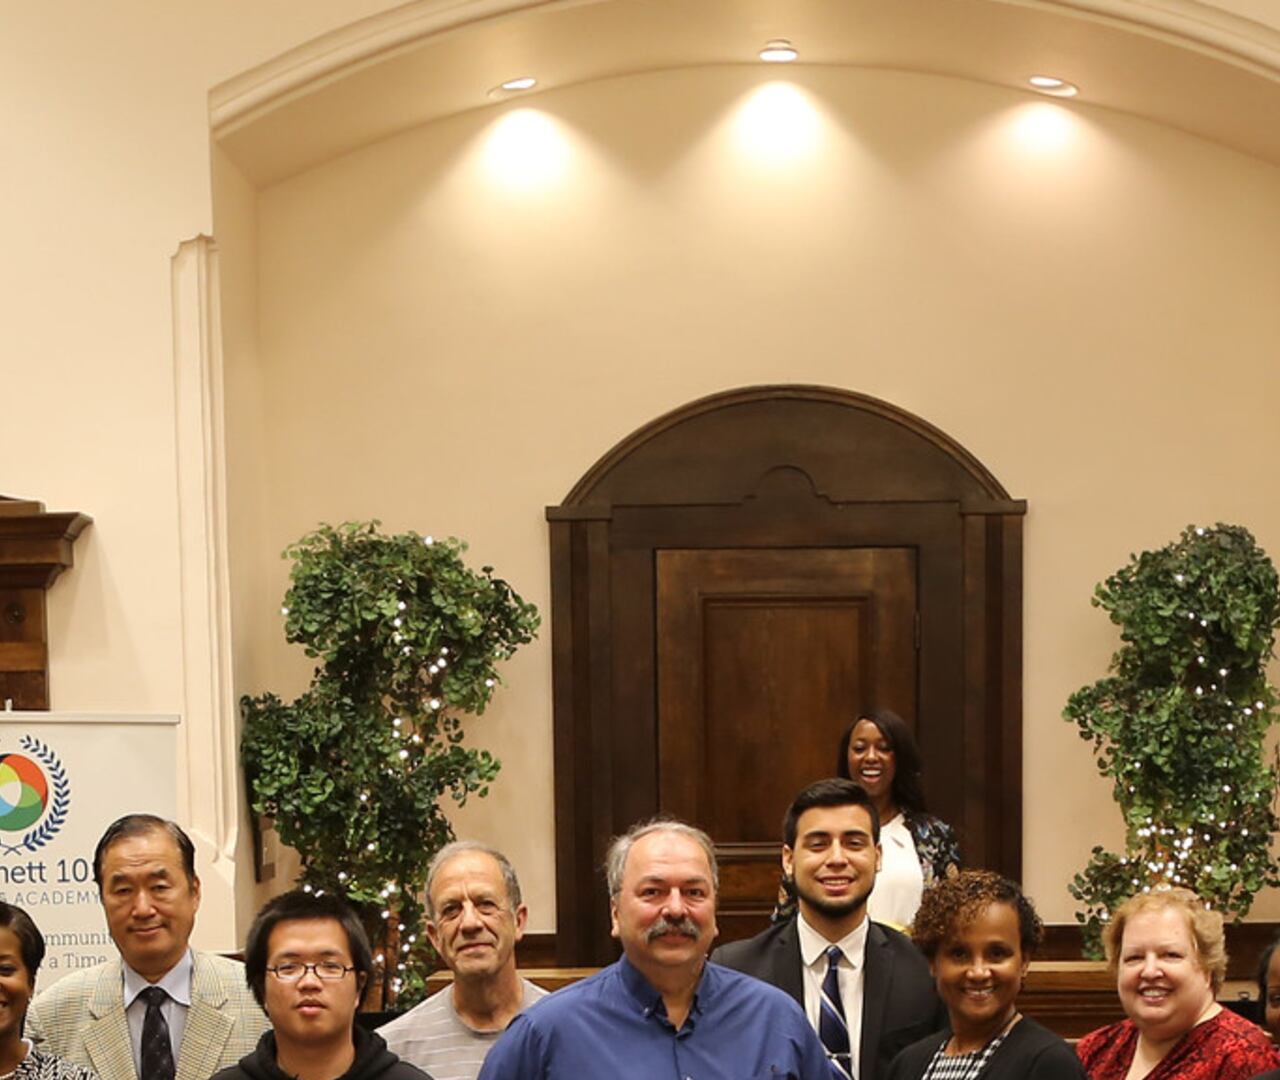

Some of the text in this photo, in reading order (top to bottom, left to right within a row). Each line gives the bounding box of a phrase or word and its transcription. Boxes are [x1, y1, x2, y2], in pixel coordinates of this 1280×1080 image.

[57, 858, 97, 883] 10
[14, 890, 101, 906] ACADEMY
[49, 953, 107, 969] a Time
